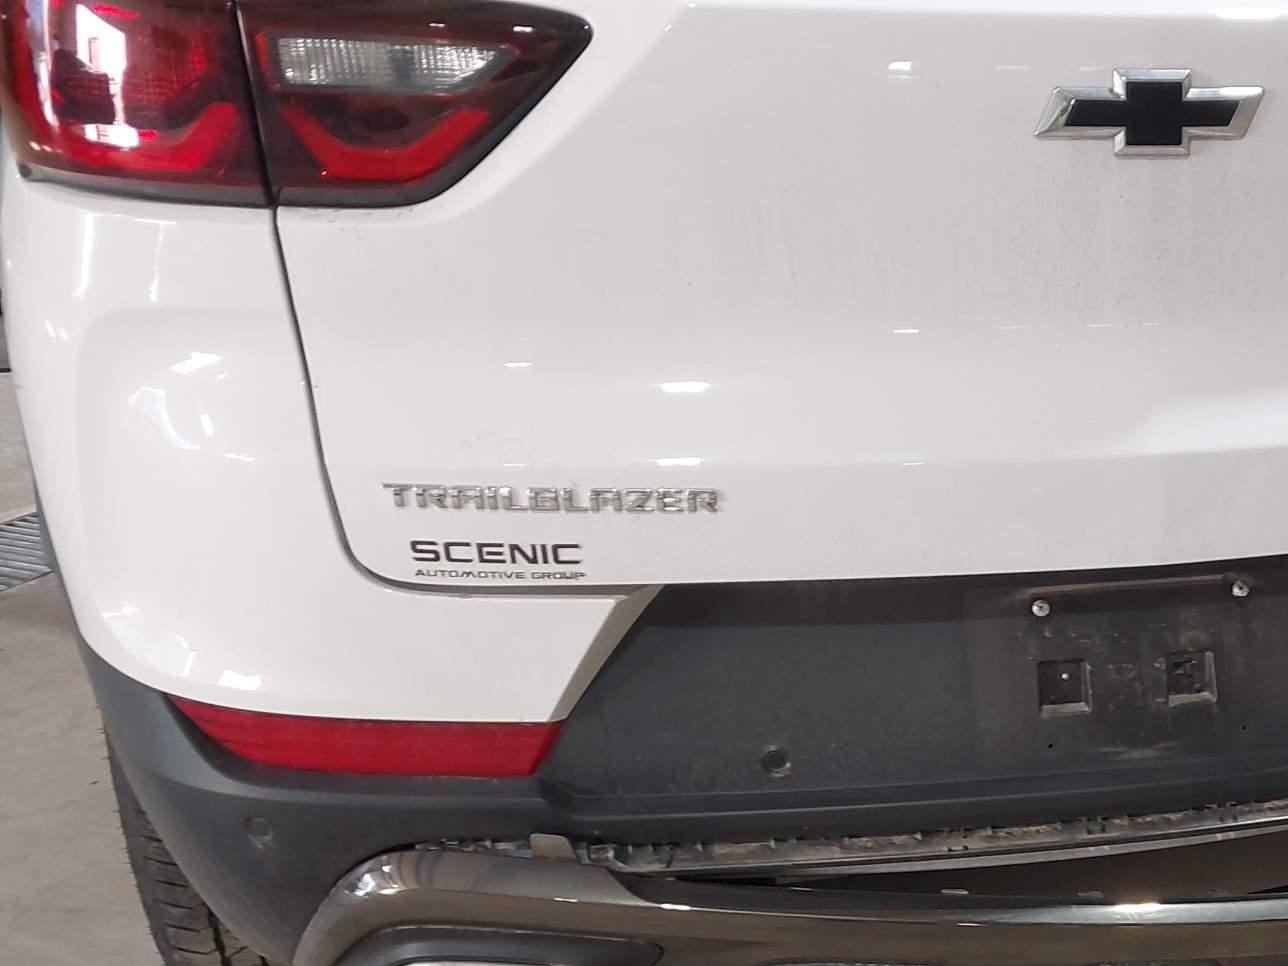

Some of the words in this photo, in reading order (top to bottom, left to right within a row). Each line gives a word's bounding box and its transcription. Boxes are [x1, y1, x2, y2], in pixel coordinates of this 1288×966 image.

[382, 482, 723, 514] TRAILBLAZER
[410, 540, 584, 565] SCENIC
[415, 568, 526, 580] AUTOMOTIVE
[531, 571, 587, 581] GROUP
